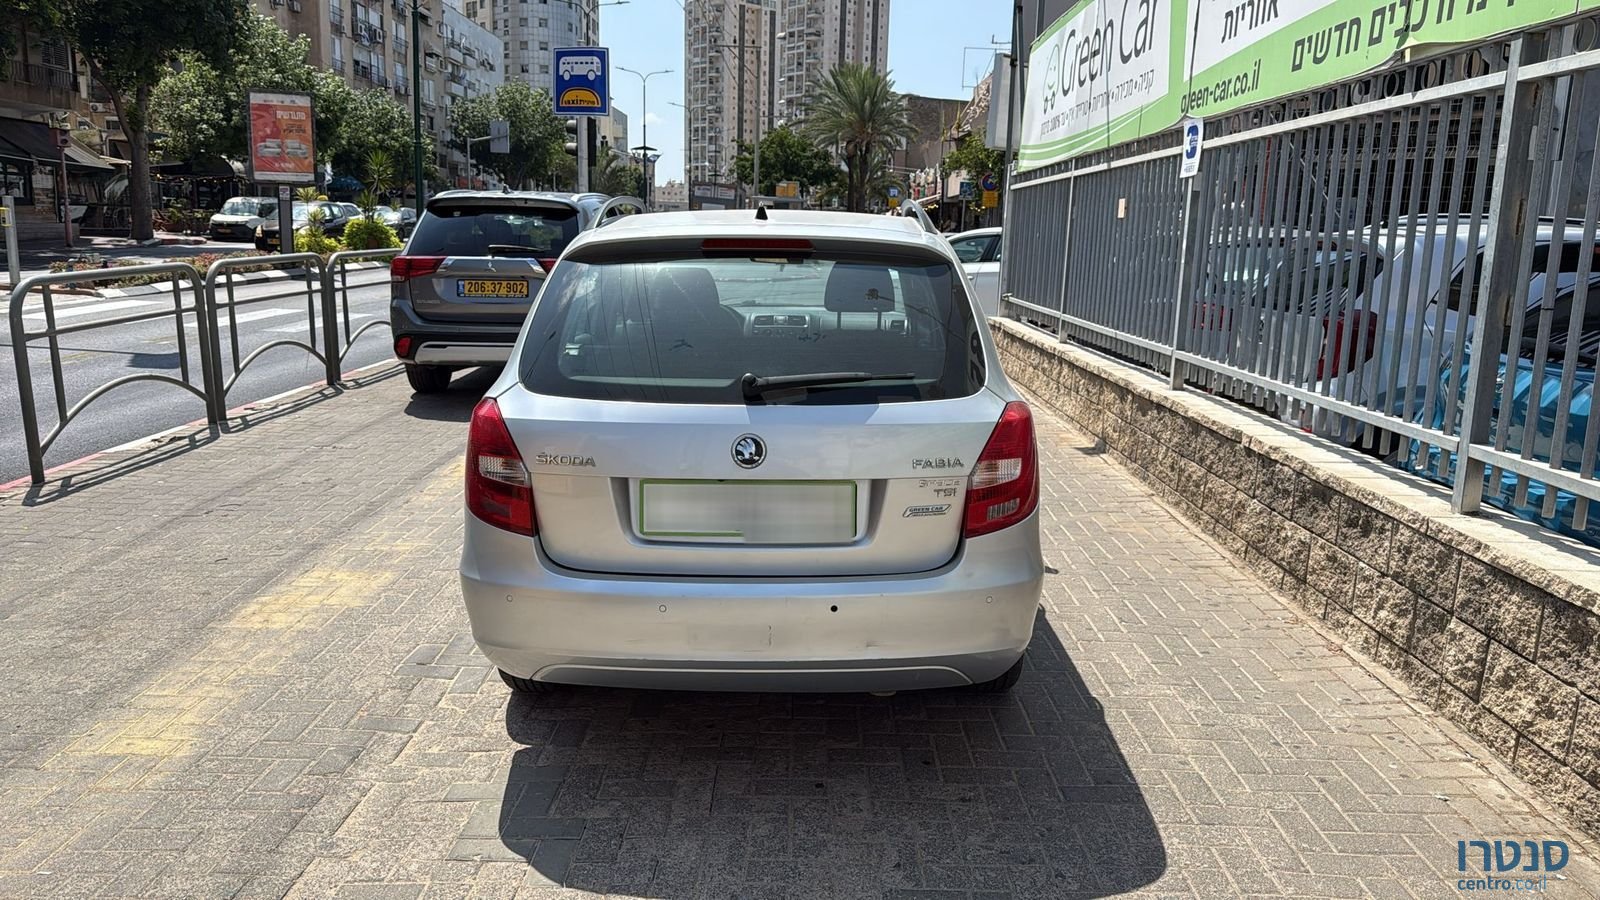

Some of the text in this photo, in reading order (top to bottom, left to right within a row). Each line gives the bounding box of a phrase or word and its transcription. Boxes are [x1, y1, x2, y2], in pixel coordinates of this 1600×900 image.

[1062, 0, 1158, 97] Green Car
[1291, 16, 1362, 72] חדשים
[912, 457, 964, 469] FABIA
[933, 488, 957, 497] TSI
